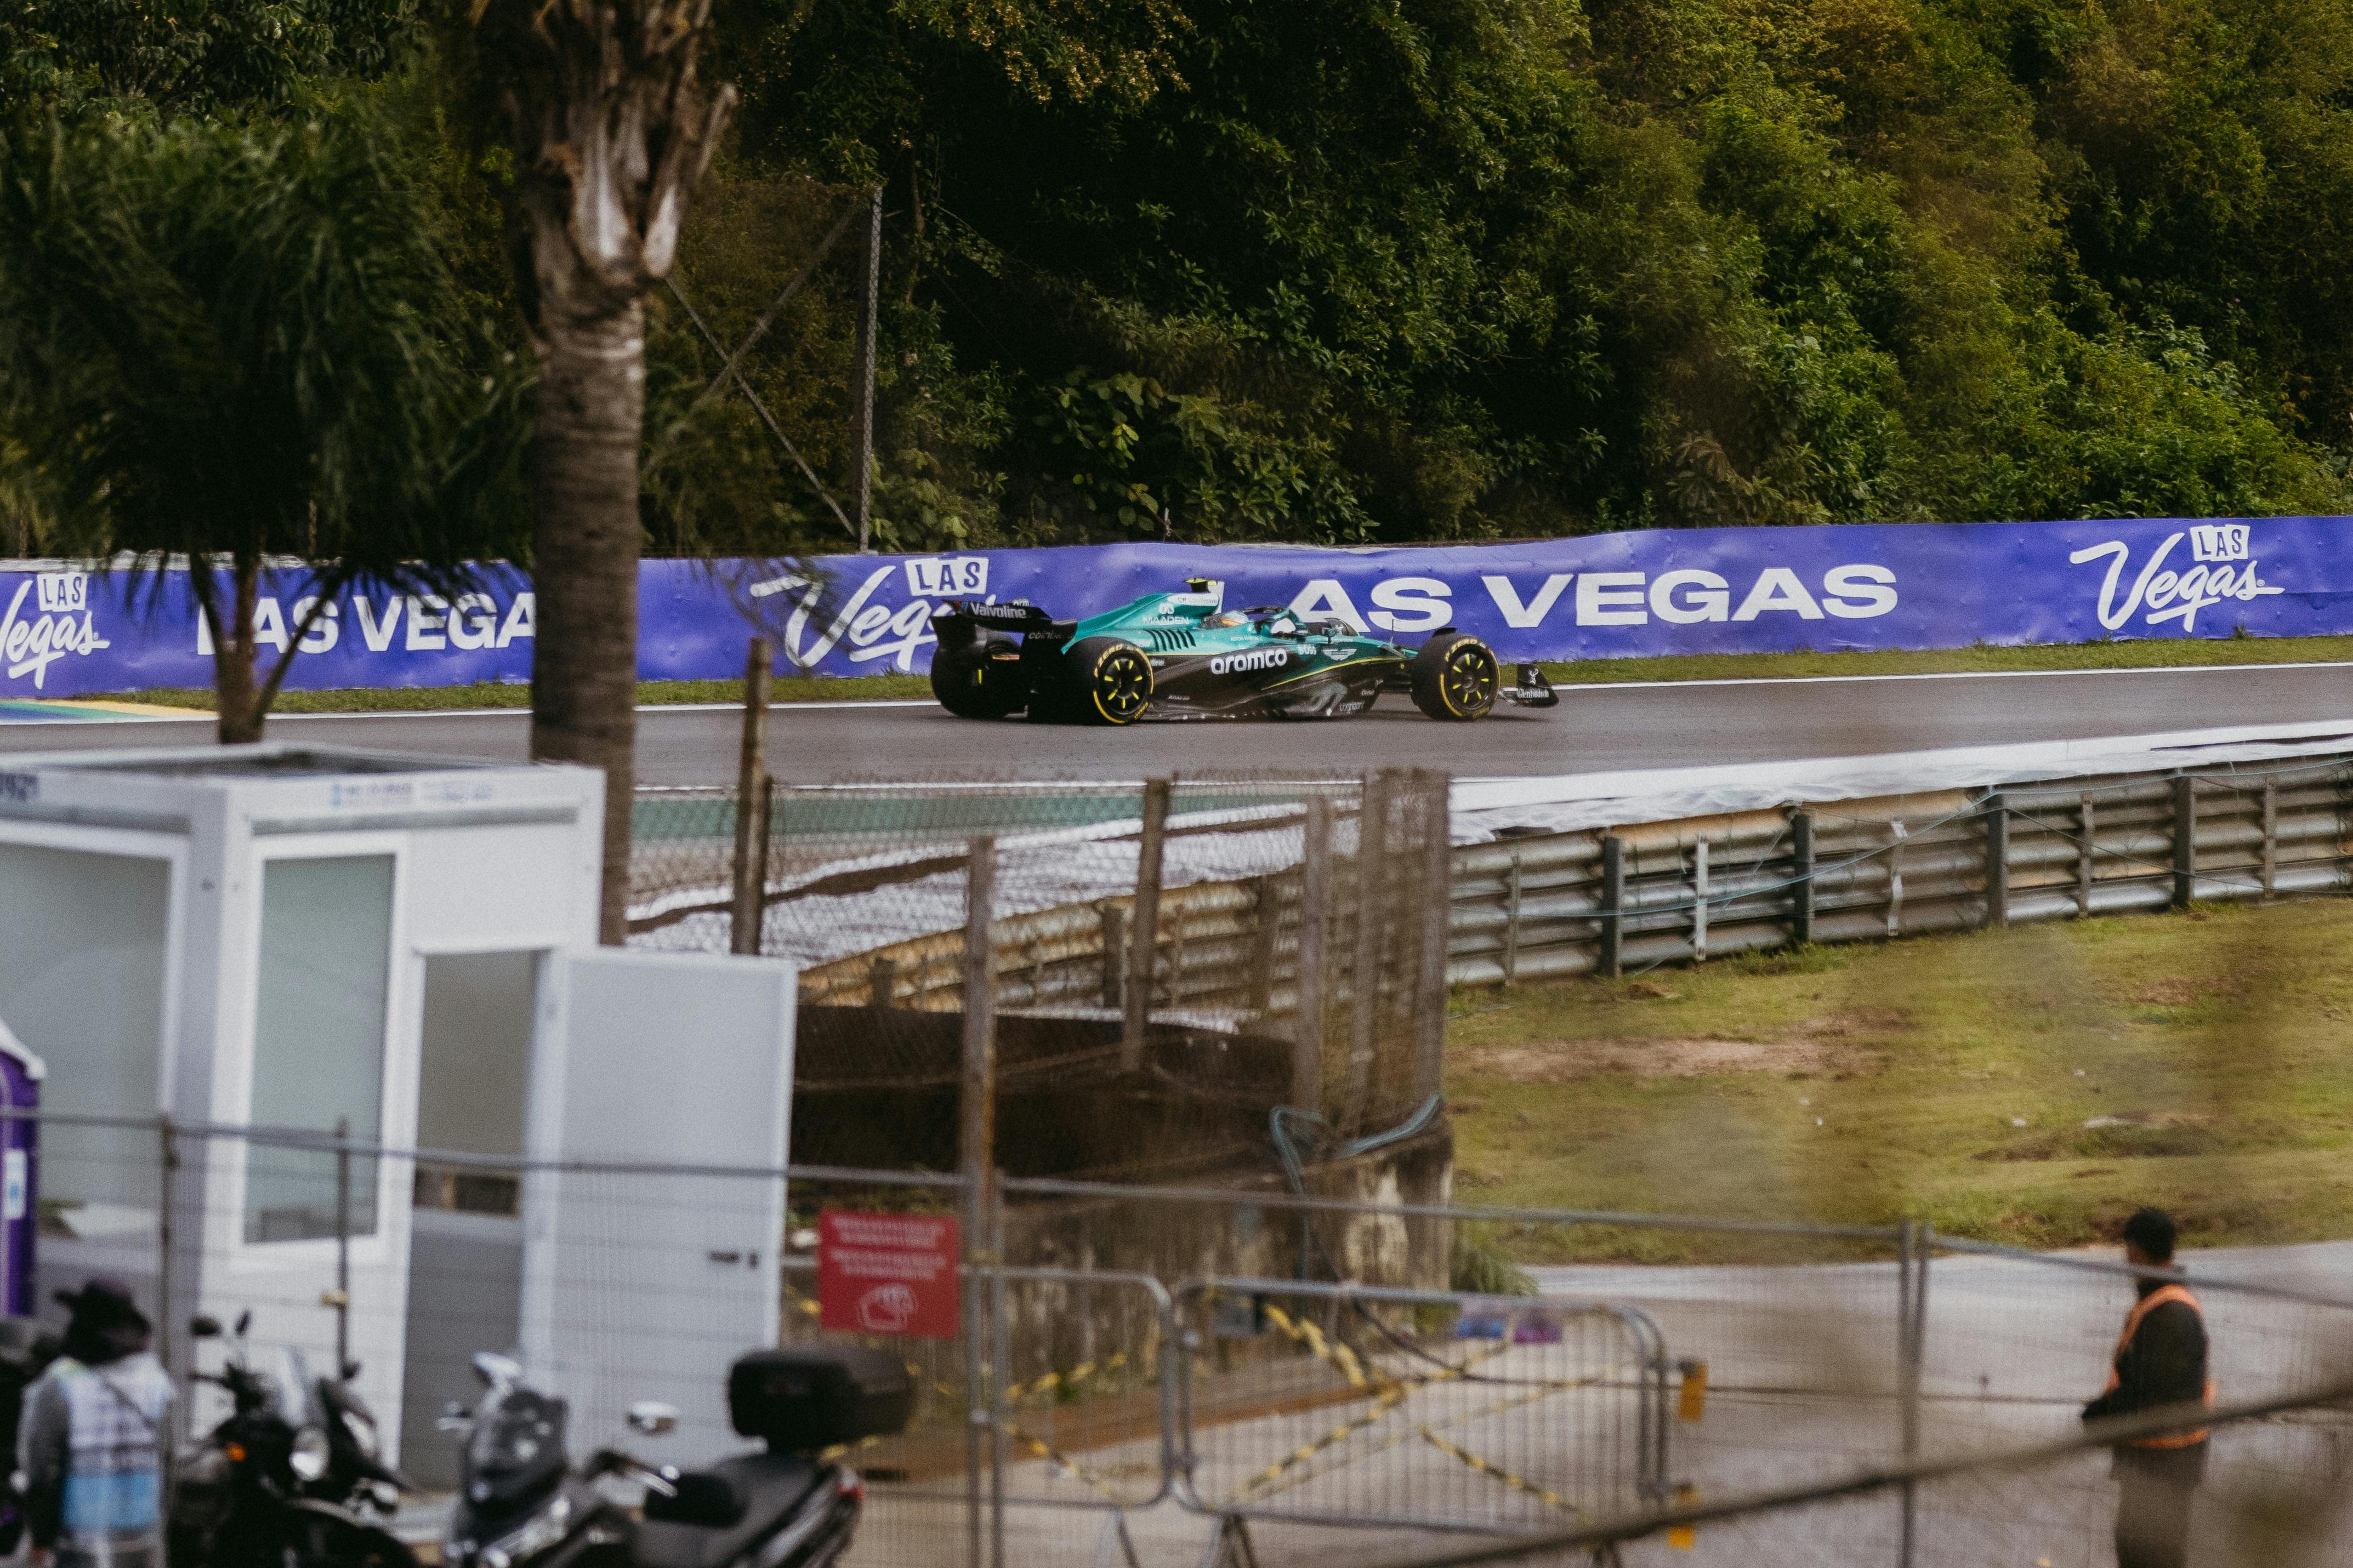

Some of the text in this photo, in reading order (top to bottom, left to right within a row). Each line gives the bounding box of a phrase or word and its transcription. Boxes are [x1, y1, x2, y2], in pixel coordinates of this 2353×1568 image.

[2198, 527, 2243, 558] LAS
[43, 575, 82, 606] LAS
[917, 561, 980, 591] LAS
[2068, 532, 2286, 633] Vegas
[970, 602, 1027, 619] Valvoline
[1481, 564, 1899, 628] VEGAS
[353, 592, 536, 652] VEGA
[749, 565, 996, 671] Veg
[1142, 615, 1189, 625] MAADEN
[1210, 648, 1288, 675] aramco
